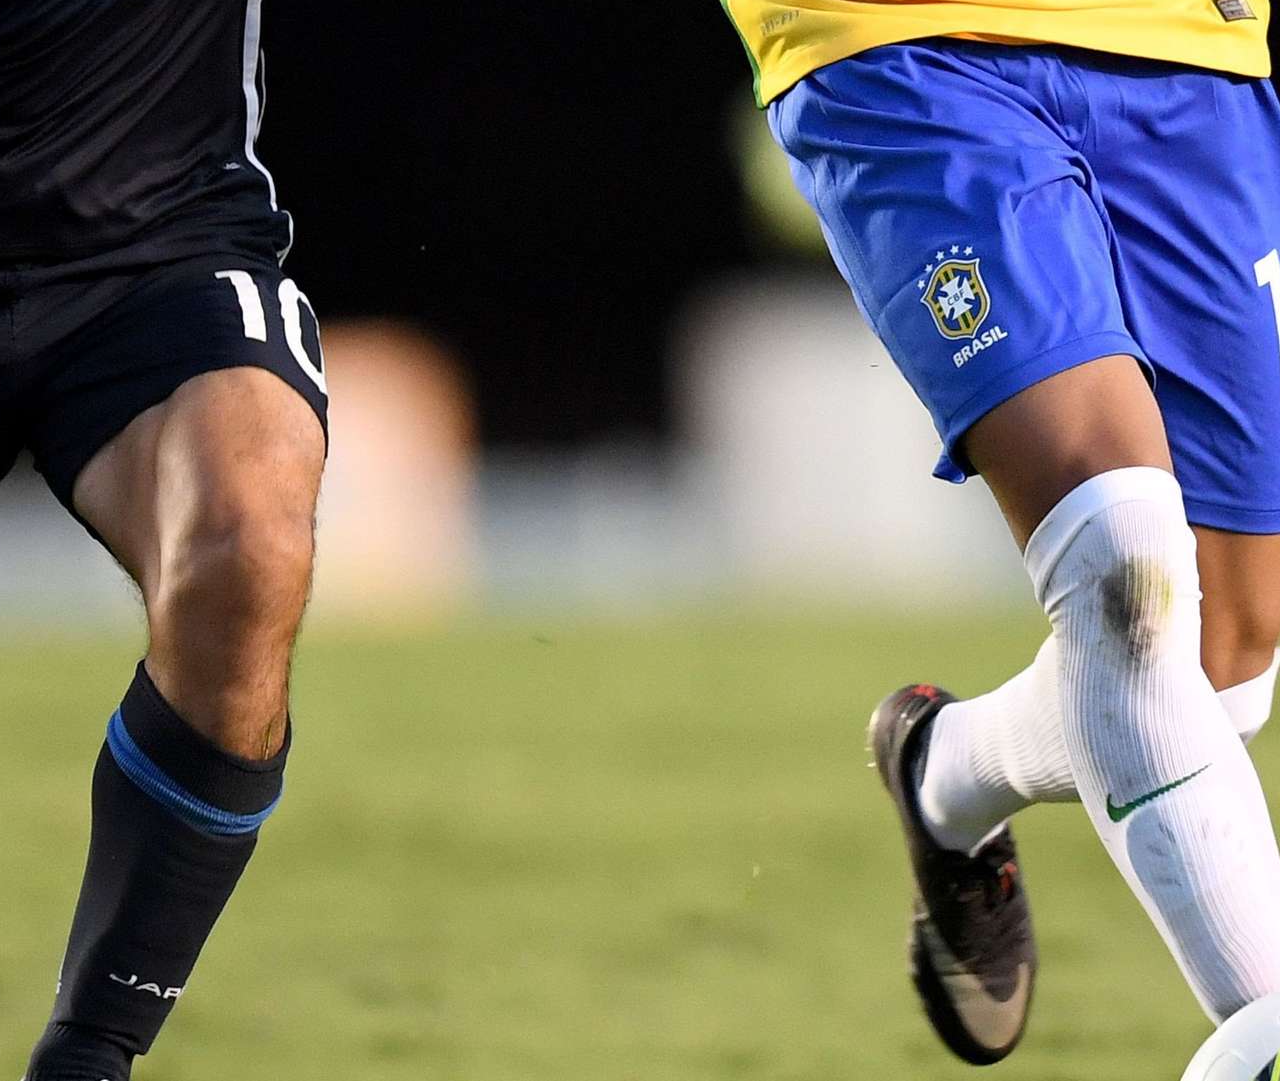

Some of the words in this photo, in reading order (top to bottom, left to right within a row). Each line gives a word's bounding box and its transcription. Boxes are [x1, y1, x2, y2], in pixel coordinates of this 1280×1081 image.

[946, 288, 965, 306] CBF
[214, 269, 326, 395] 10
[952, 325, 1009, 369] BRASIL
